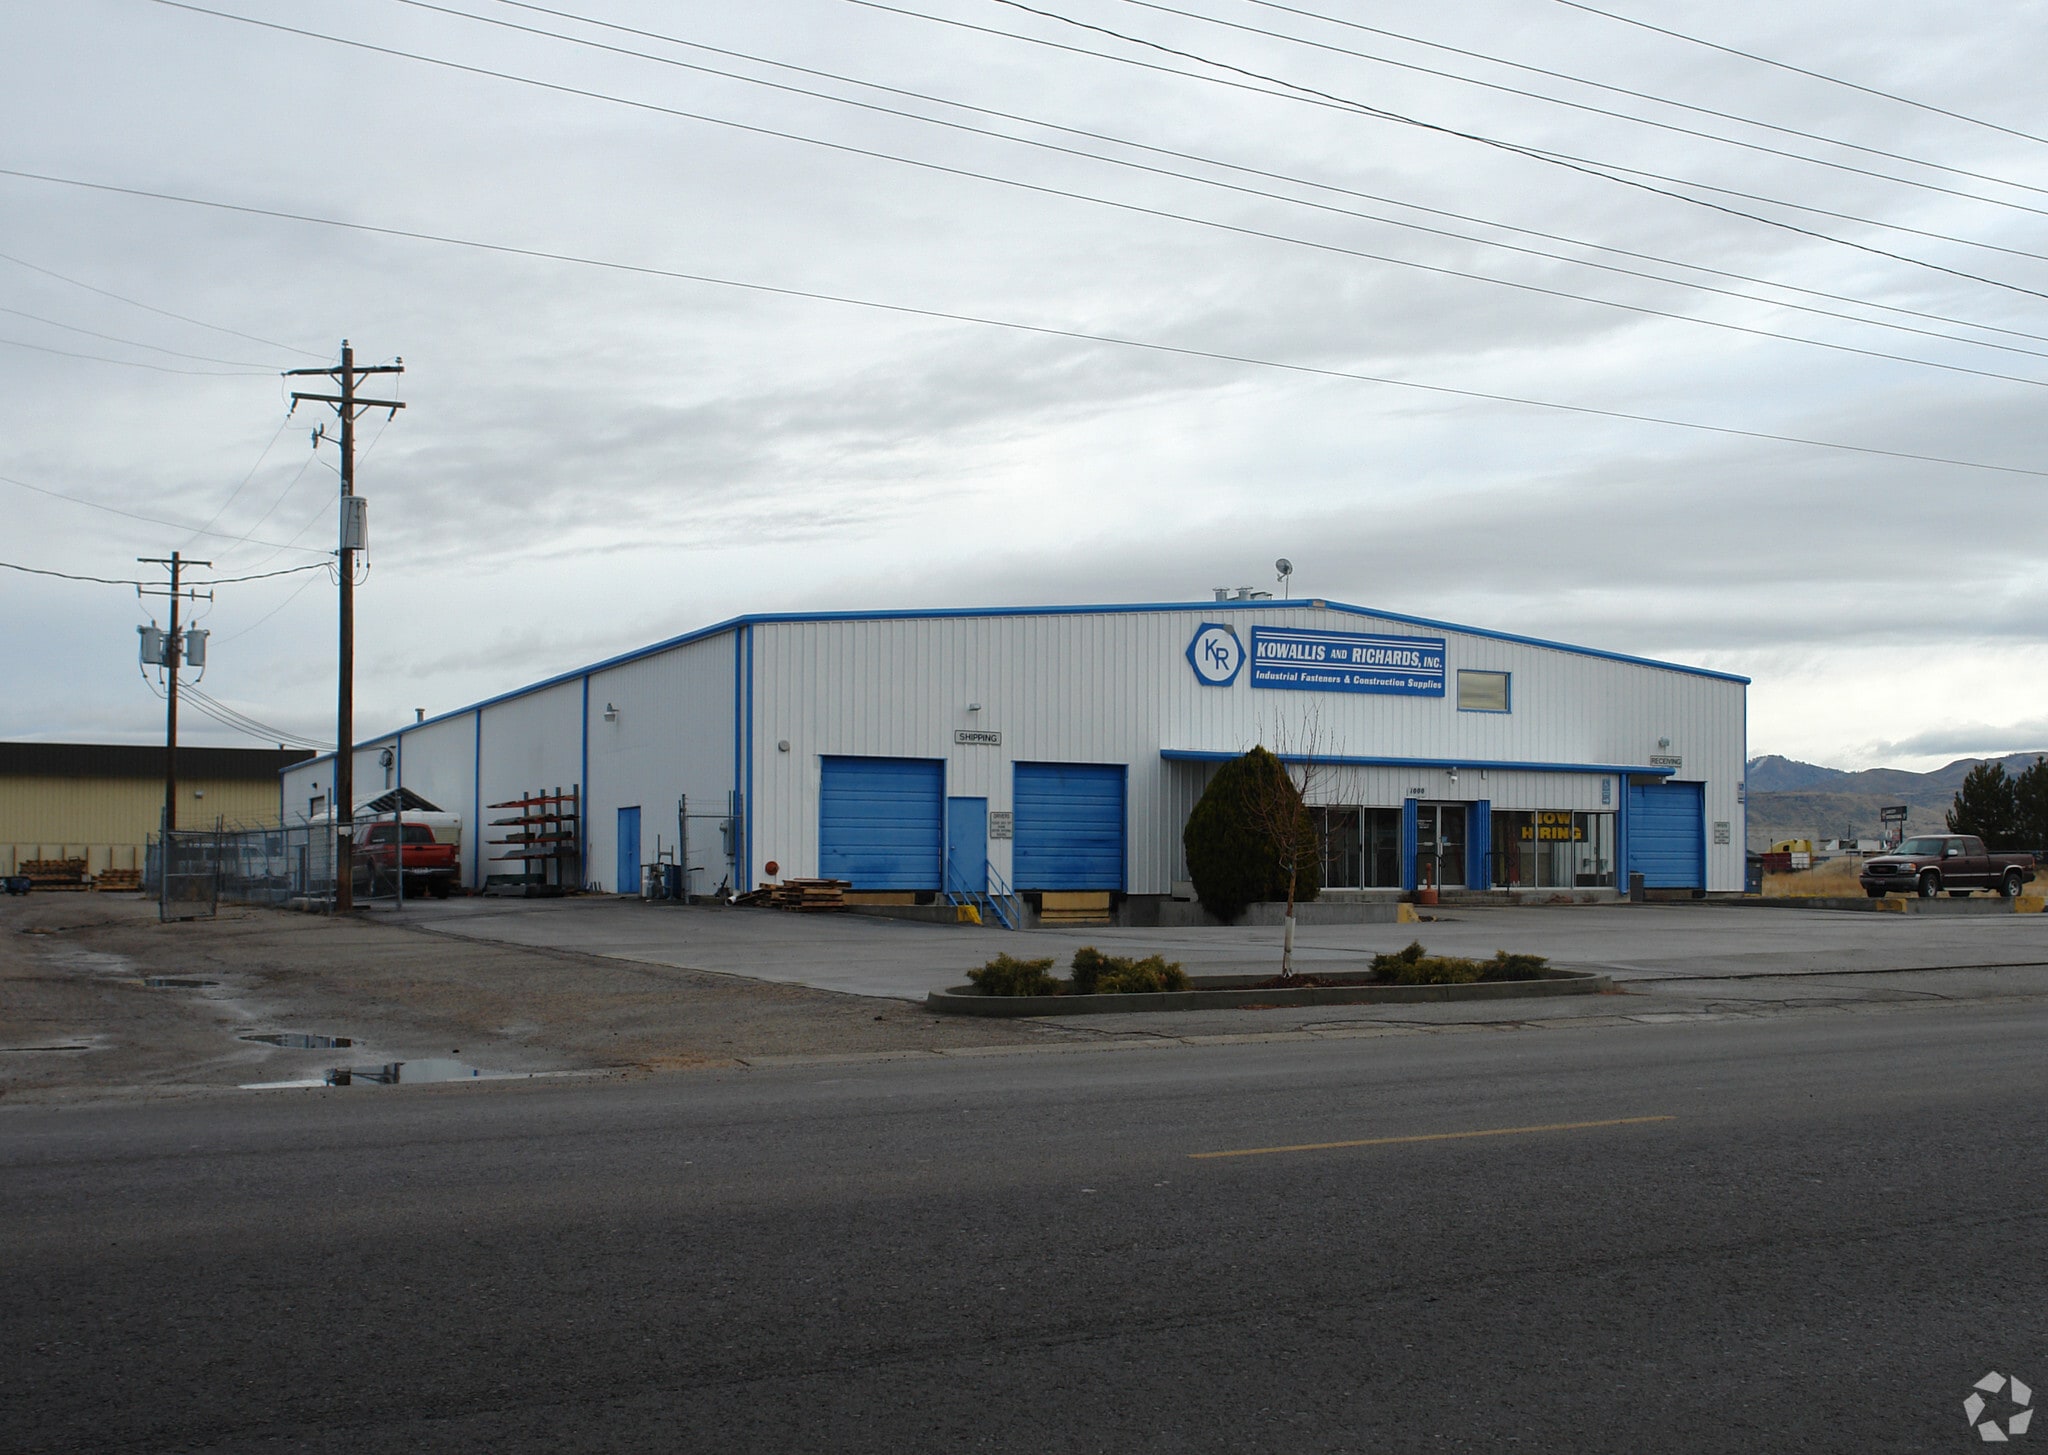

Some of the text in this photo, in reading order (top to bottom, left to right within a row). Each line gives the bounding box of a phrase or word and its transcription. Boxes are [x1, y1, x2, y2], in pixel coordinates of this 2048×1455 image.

[1256, 641, 1443, 669] KOWALLIS AND RICHARDS, INC.
[1255, 670, 1442, 690] Industrial Fasteners & Construction Supplies
[959, 732, 997, 743] SHIPPING
